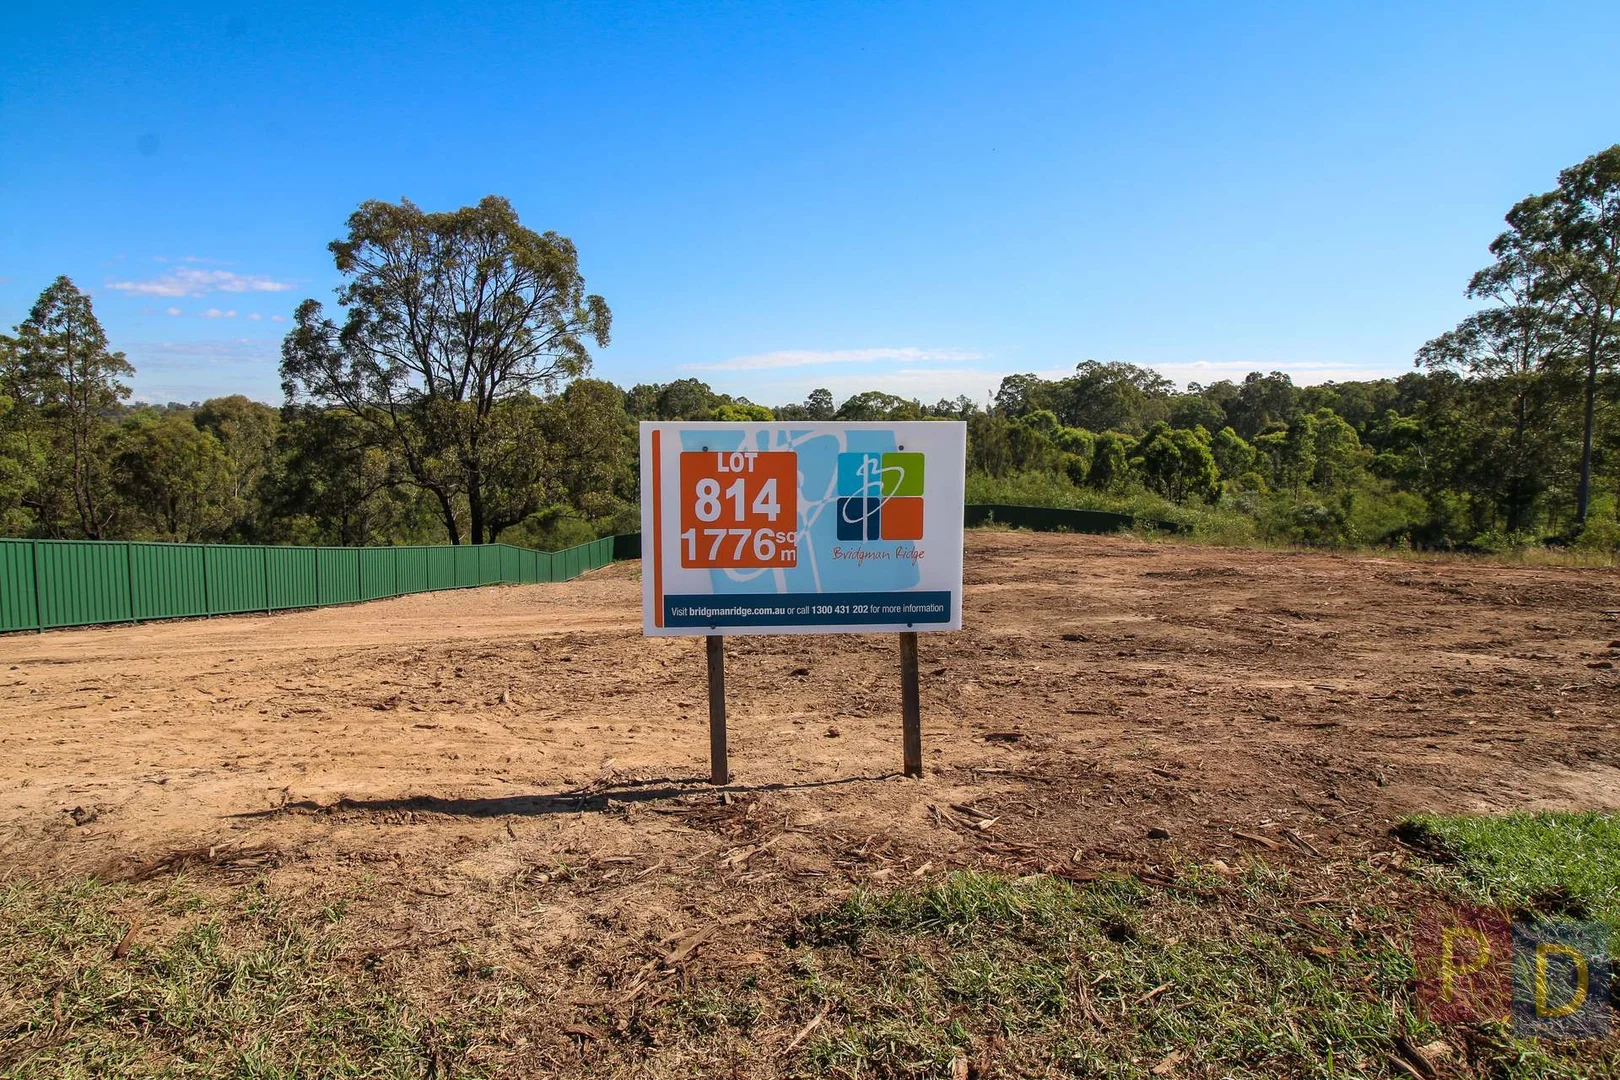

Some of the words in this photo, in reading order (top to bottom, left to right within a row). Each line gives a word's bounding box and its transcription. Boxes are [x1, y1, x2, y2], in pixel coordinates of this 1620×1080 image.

[717, 452, 758, 473] LOT
[694, 477, 781, 522] 814
[681, 527, 776, 561] 1776
[832, 546, 891, 567] Bridgman
[894, 546, 925, 566] Ridge
[671, 607, 688, 616] Visit
[689, 606, 785, 617] bridgmanridge.com.au
[796, 606, 810, 614] call
[811, 606, 833, 614] 1300
[834, 606, 850, 614] 431
[852, 605, 868, 614] 202
[870, 604, 880, 613] for
[902, 604, 944, 613] information
